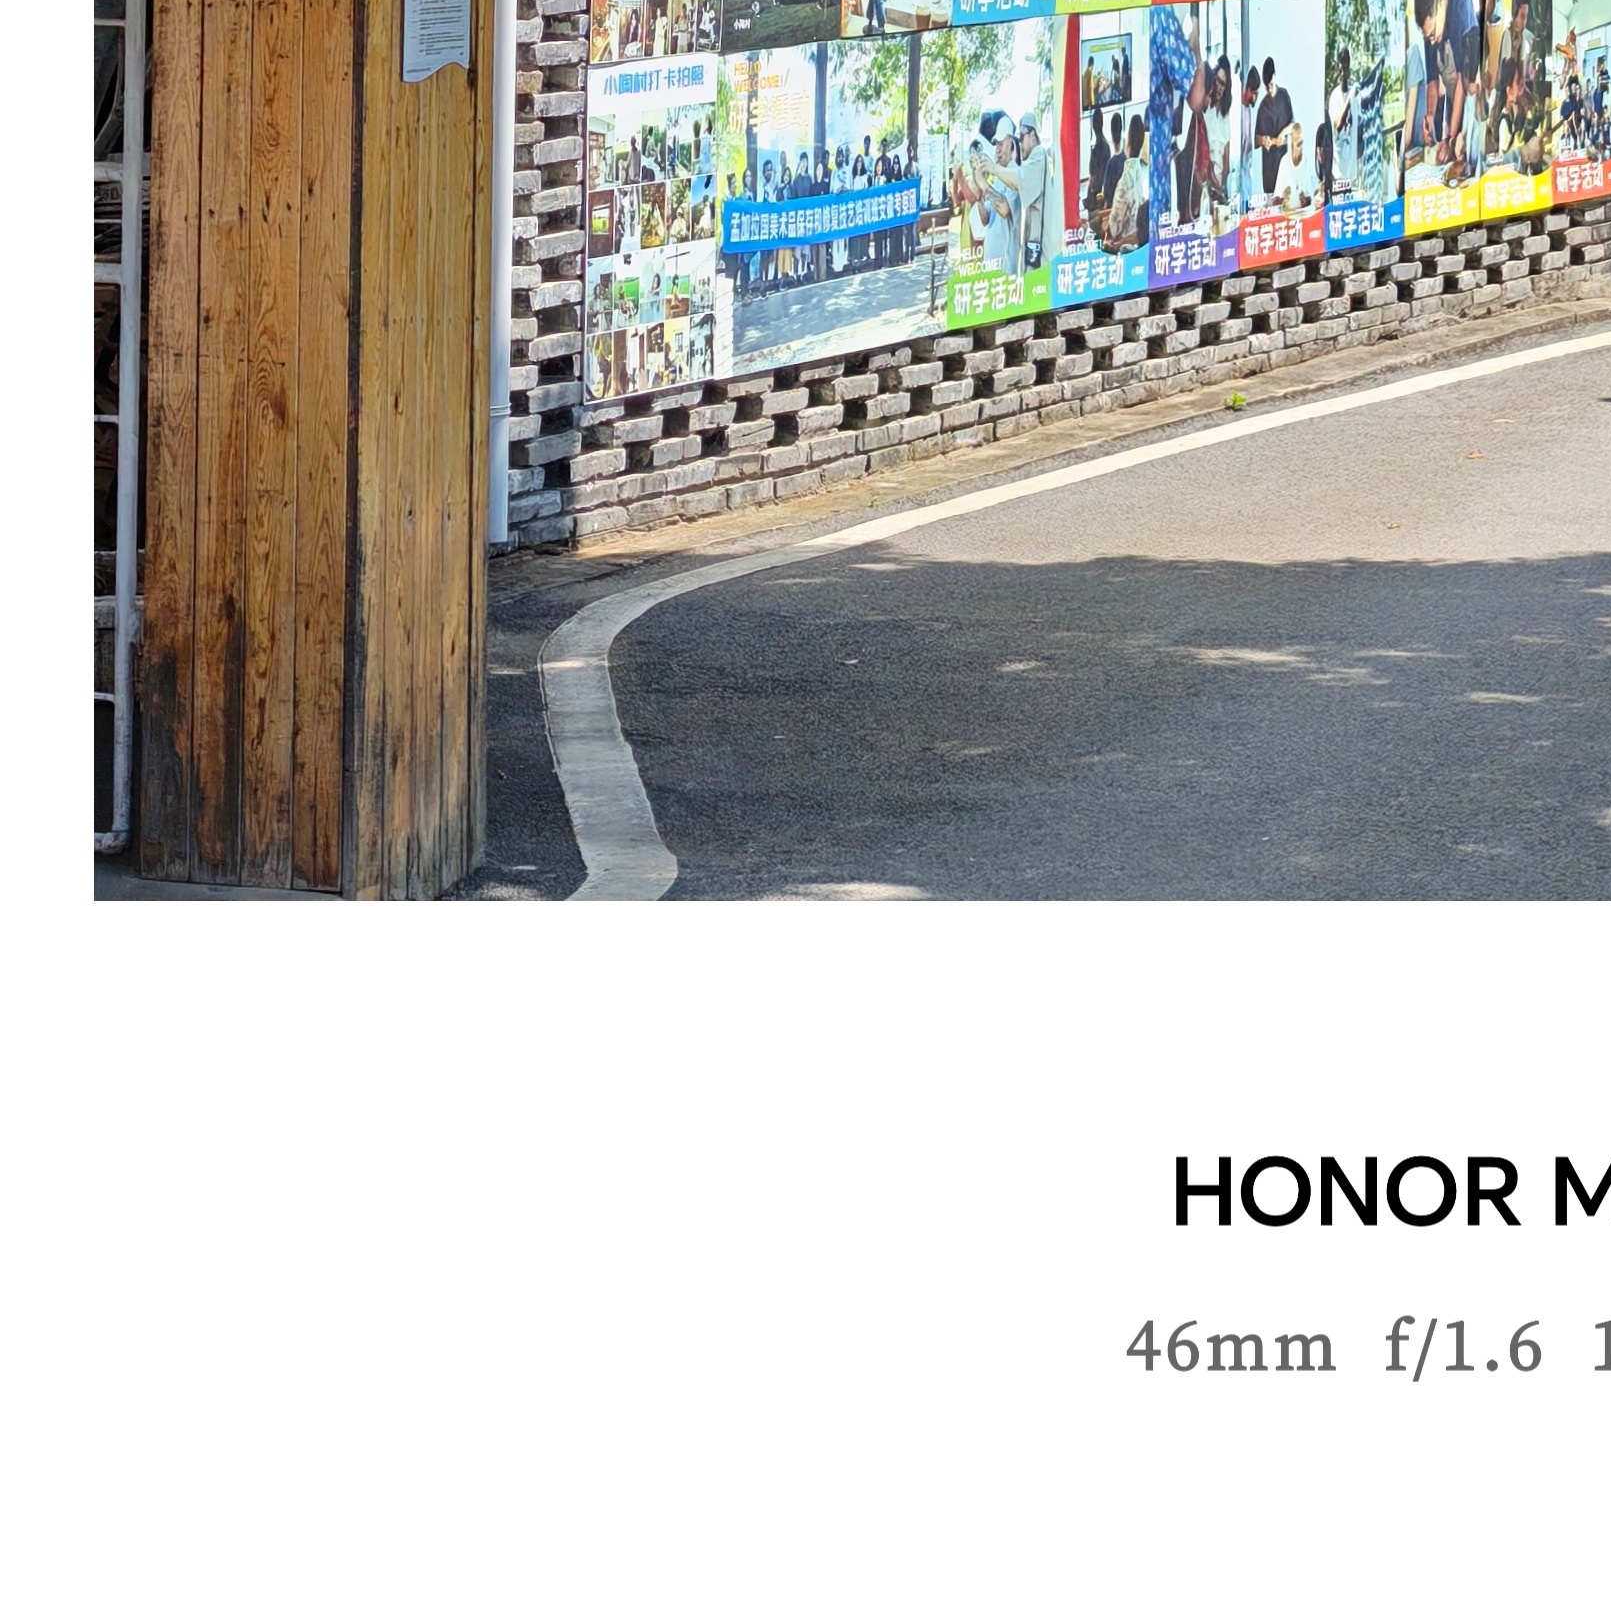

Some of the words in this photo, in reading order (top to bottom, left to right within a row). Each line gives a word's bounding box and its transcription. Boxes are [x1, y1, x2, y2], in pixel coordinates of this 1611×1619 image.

[603, 65, 704, 96] 小陶村打卡拍照
[734, 61, 762, 76] HELLO
[1556, 162, 1604, 193] 研学活动
[1244, 219, 1303, 257] 研学活动
[1329, 203, 1385, 240] 研学活动
[1057, 253, 1124, 295] 研学活动
[1155, 235, 1217, 276] 研学活动
[953, 274, 1025, 316] 研学活动
